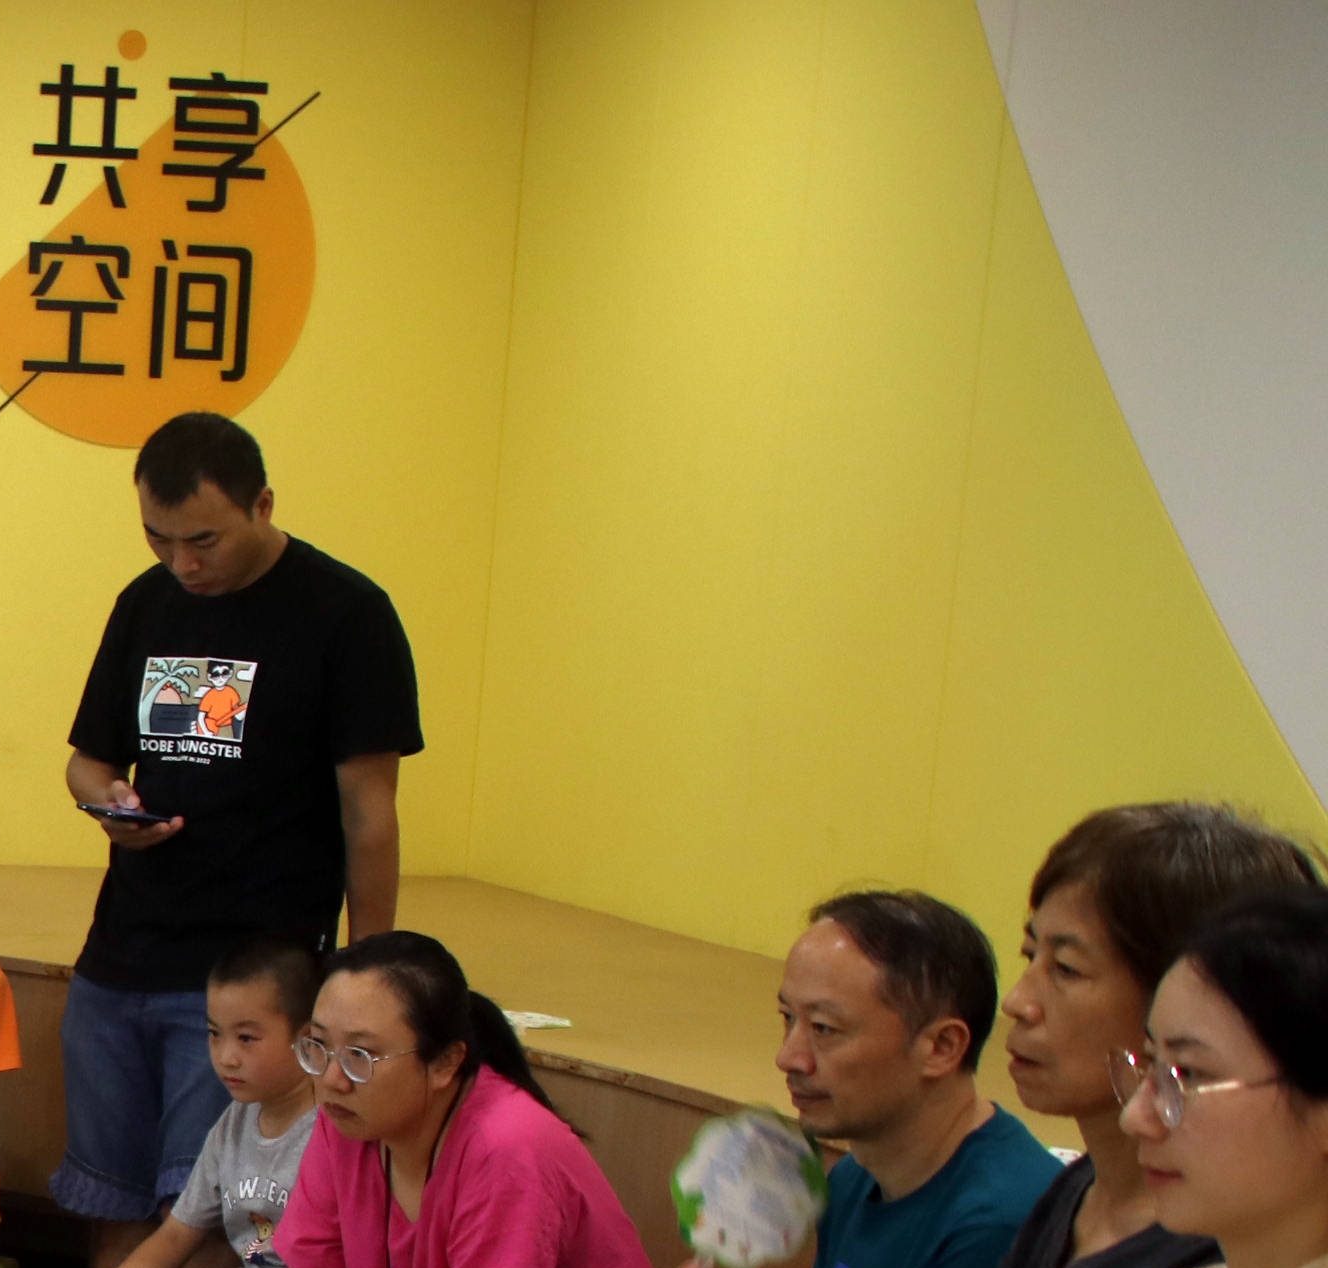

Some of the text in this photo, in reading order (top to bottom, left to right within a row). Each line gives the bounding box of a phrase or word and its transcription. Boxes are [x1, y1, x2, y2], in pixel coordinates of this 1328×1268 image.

[33, 64, 269, 213] 共享
[23, 235, 253, 382] 空间
[140, 738, 243, 759] DOBE UNGSTER
